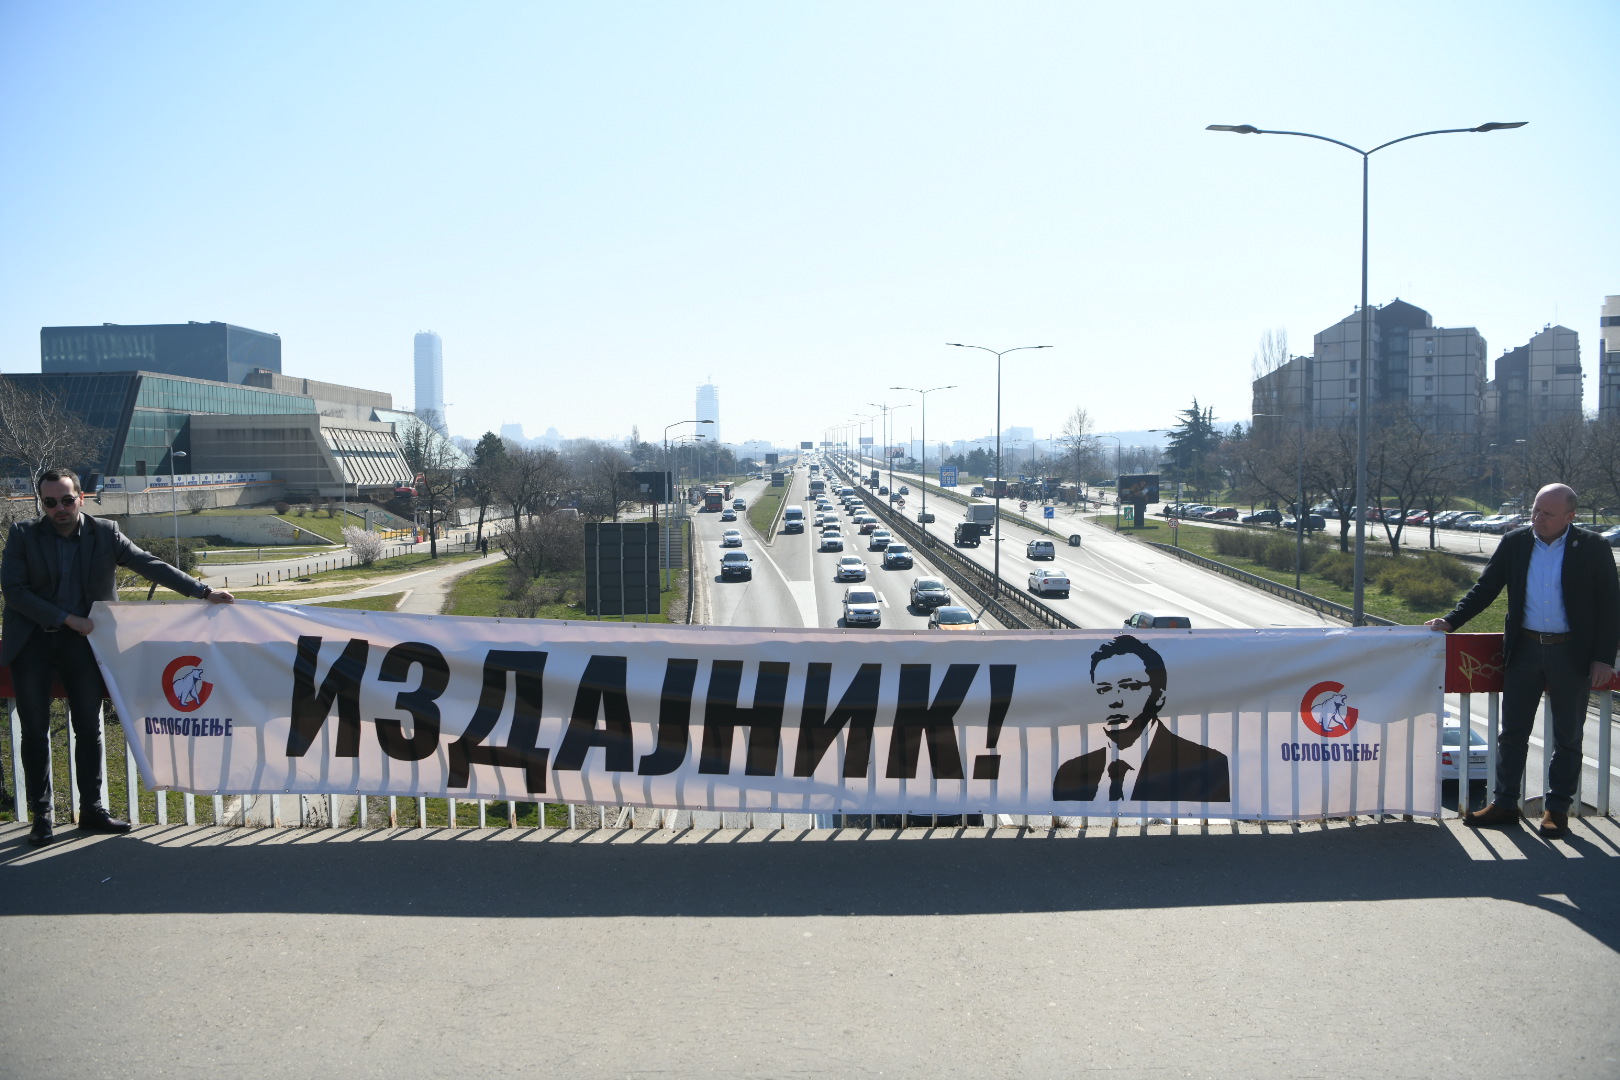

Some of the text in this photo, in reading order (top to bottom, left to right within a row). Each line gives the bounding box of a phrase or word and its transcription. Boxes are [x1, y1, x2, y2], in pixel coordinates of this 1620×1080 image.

[285, 635, 1017, 794] ИЗДАЈНИК!
[144, 716, 233, 737] ОСЛОБОЂЕЊЕ
[1280, 742, 1381, 762] ОСЛОБОЂЕЊЕ
